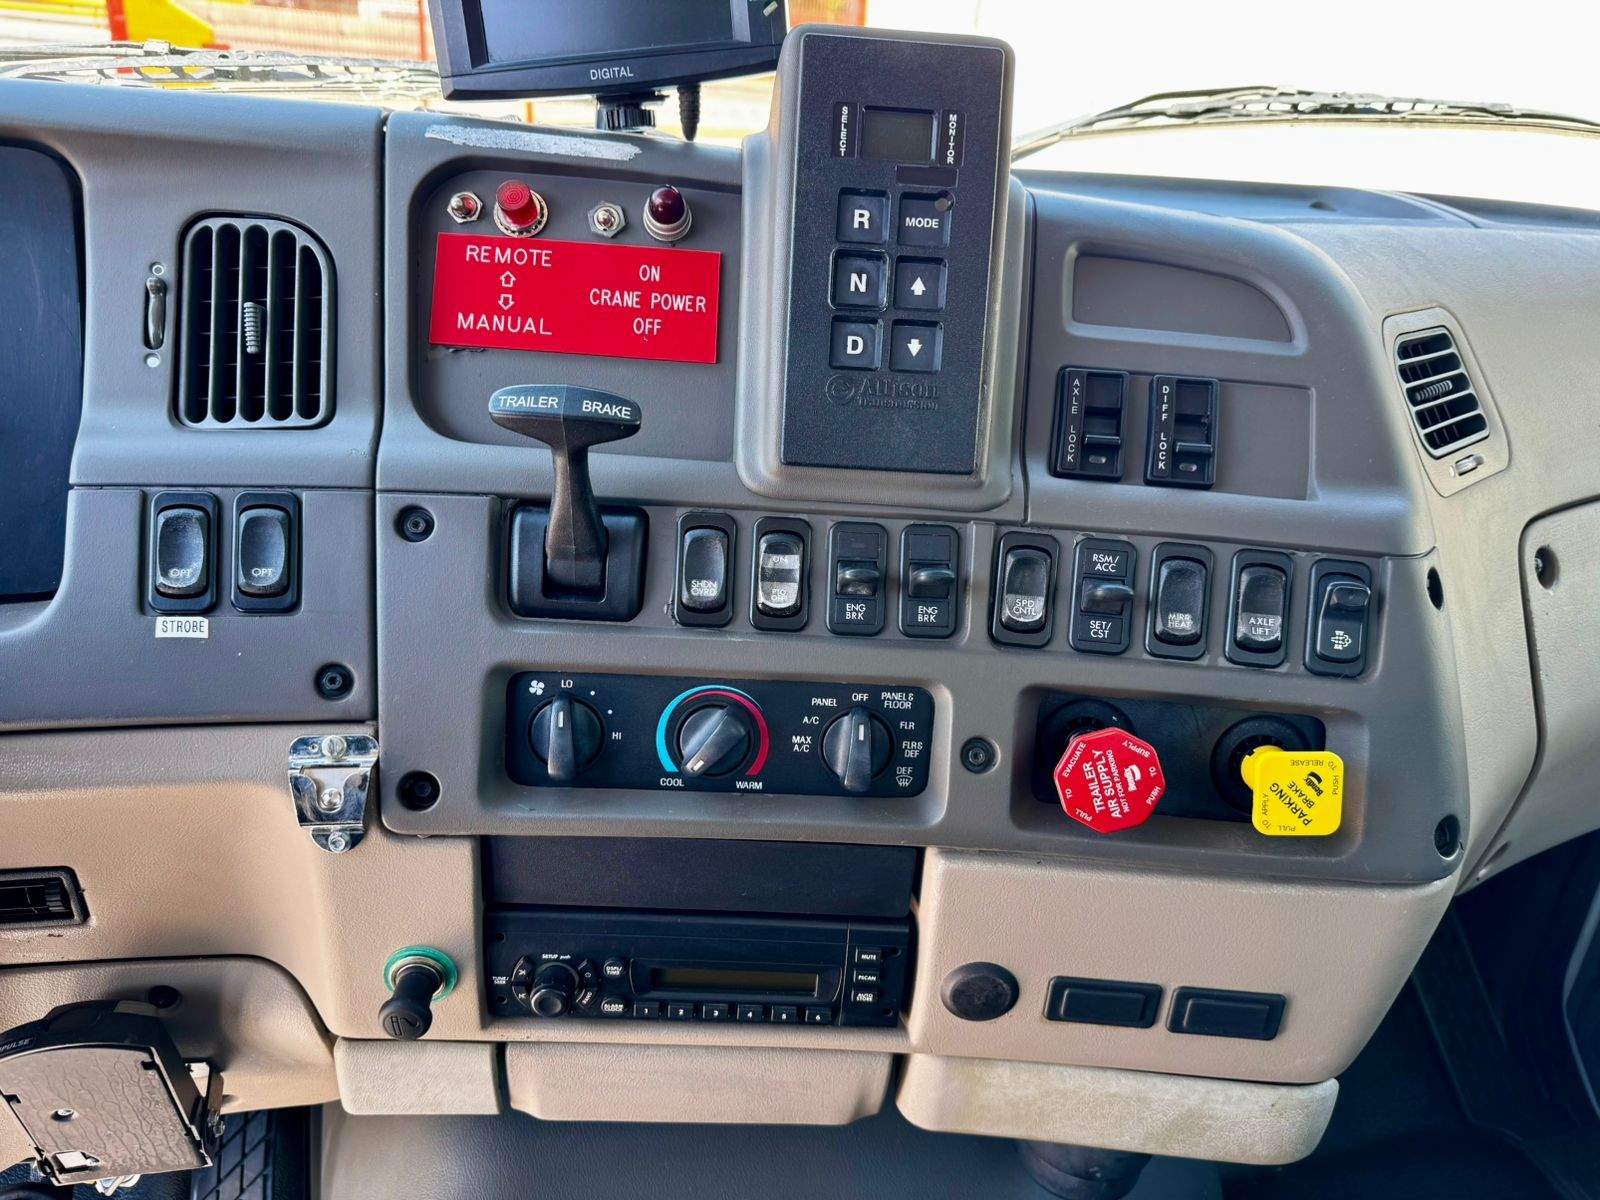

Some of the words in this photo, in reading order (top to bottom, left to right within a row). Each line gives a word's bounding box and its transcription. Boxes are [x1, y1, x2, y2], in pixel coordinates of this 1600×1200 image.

[589, 66, 634, 81] DIGITAL
[838, 106, 848, 157] SELECT
[946, 114, 957, 165] MONITOR
[853, 209, 870, 229] R
[905, 217, 939, 229] MODE
[465, 244, 553, 268] REMOTE
[638, 264, 661, 282] ON
[850, 273, 867, 293] N
[589, 288, 642, 309] CRANE
[650, 292, 707, 313] POWER
[456, 312, 553, 336] MANUAL
[632, 318, 662, 335] OFF
[846, 335, 864, 355] D
[1071, 378, 1081, 414] AXLE
[498, 395, 559, 409] TRAILER
[582, 400, 632, 419] BRAKE
[1161, 385, 1170, 422] DIFF
[1067, 425, 1077, 462] LOCK
[1158, 432, 1167, 470] LOCK
[1092, 553, 1119, 564] RSM/
[252, 568, 273, 577] OPT
[1094, 563, 1117, 572] ACC
[846, 603, 866, 613] ENG
[1015, 599, 1035, 608] SPD
[918, 605, 938, 615] ENG
[1013, 605, 1037, 616] CNTL
[845, 611, 865, 621] BRK
[917, 614, 937, 623] BRK
[1249, 616, 1275, 627] AXLE
[161, 620, 205, 633] STROBE
[1089, 620, 1112, 630] SET/
[1090, 629, 1109, 639] CST
[1251, 626, 1271, 636] LIFT
[561, 679, 573, 689] LO
[811, 697, 837, 707] PANEL
[852, 693, 869, 702] OFF
[881, 692, 907, 701] PANEL
[884, 700, 912, 710] FLOOR
[802, 716, 820, 725] A/C
[900, 721, 915, 730] FLR
[612, 731, 622, 740] HI
[791, 735, 812, 744] MAX
[793, 745, 810, 753] A/C
[904, 749, 920, 758] DEF
[1121, 740, 1151, 758] SUPPLY
[1062, 742, 1086, 778] EVACUATE
[1106, 749, 1120, 782] PARKING
[1290, 759, 1324, 767] RELEASE
[896, 766, 913, 775] DEF
[1092, 749, 1115, 797] SUPPLY
[1148, 766, 1157, 777] TO
[660, 777, 685, 787] COOL
[735, 780, 763, 790] WARM
[1082, 761, 1106, 814] TRAILER
[1065, 788, 1073, 799] TO
[1145, 785, 1161, 805] PUSH
[1287, 780, 1316, 809] BRAKE
[1107, 797, 1123, 818] AIR
[1119, 798, 1130, 813] NOT
[1269, 782, 1313, 827] PARKING
[1075, 808, 1093, 822] PULL
